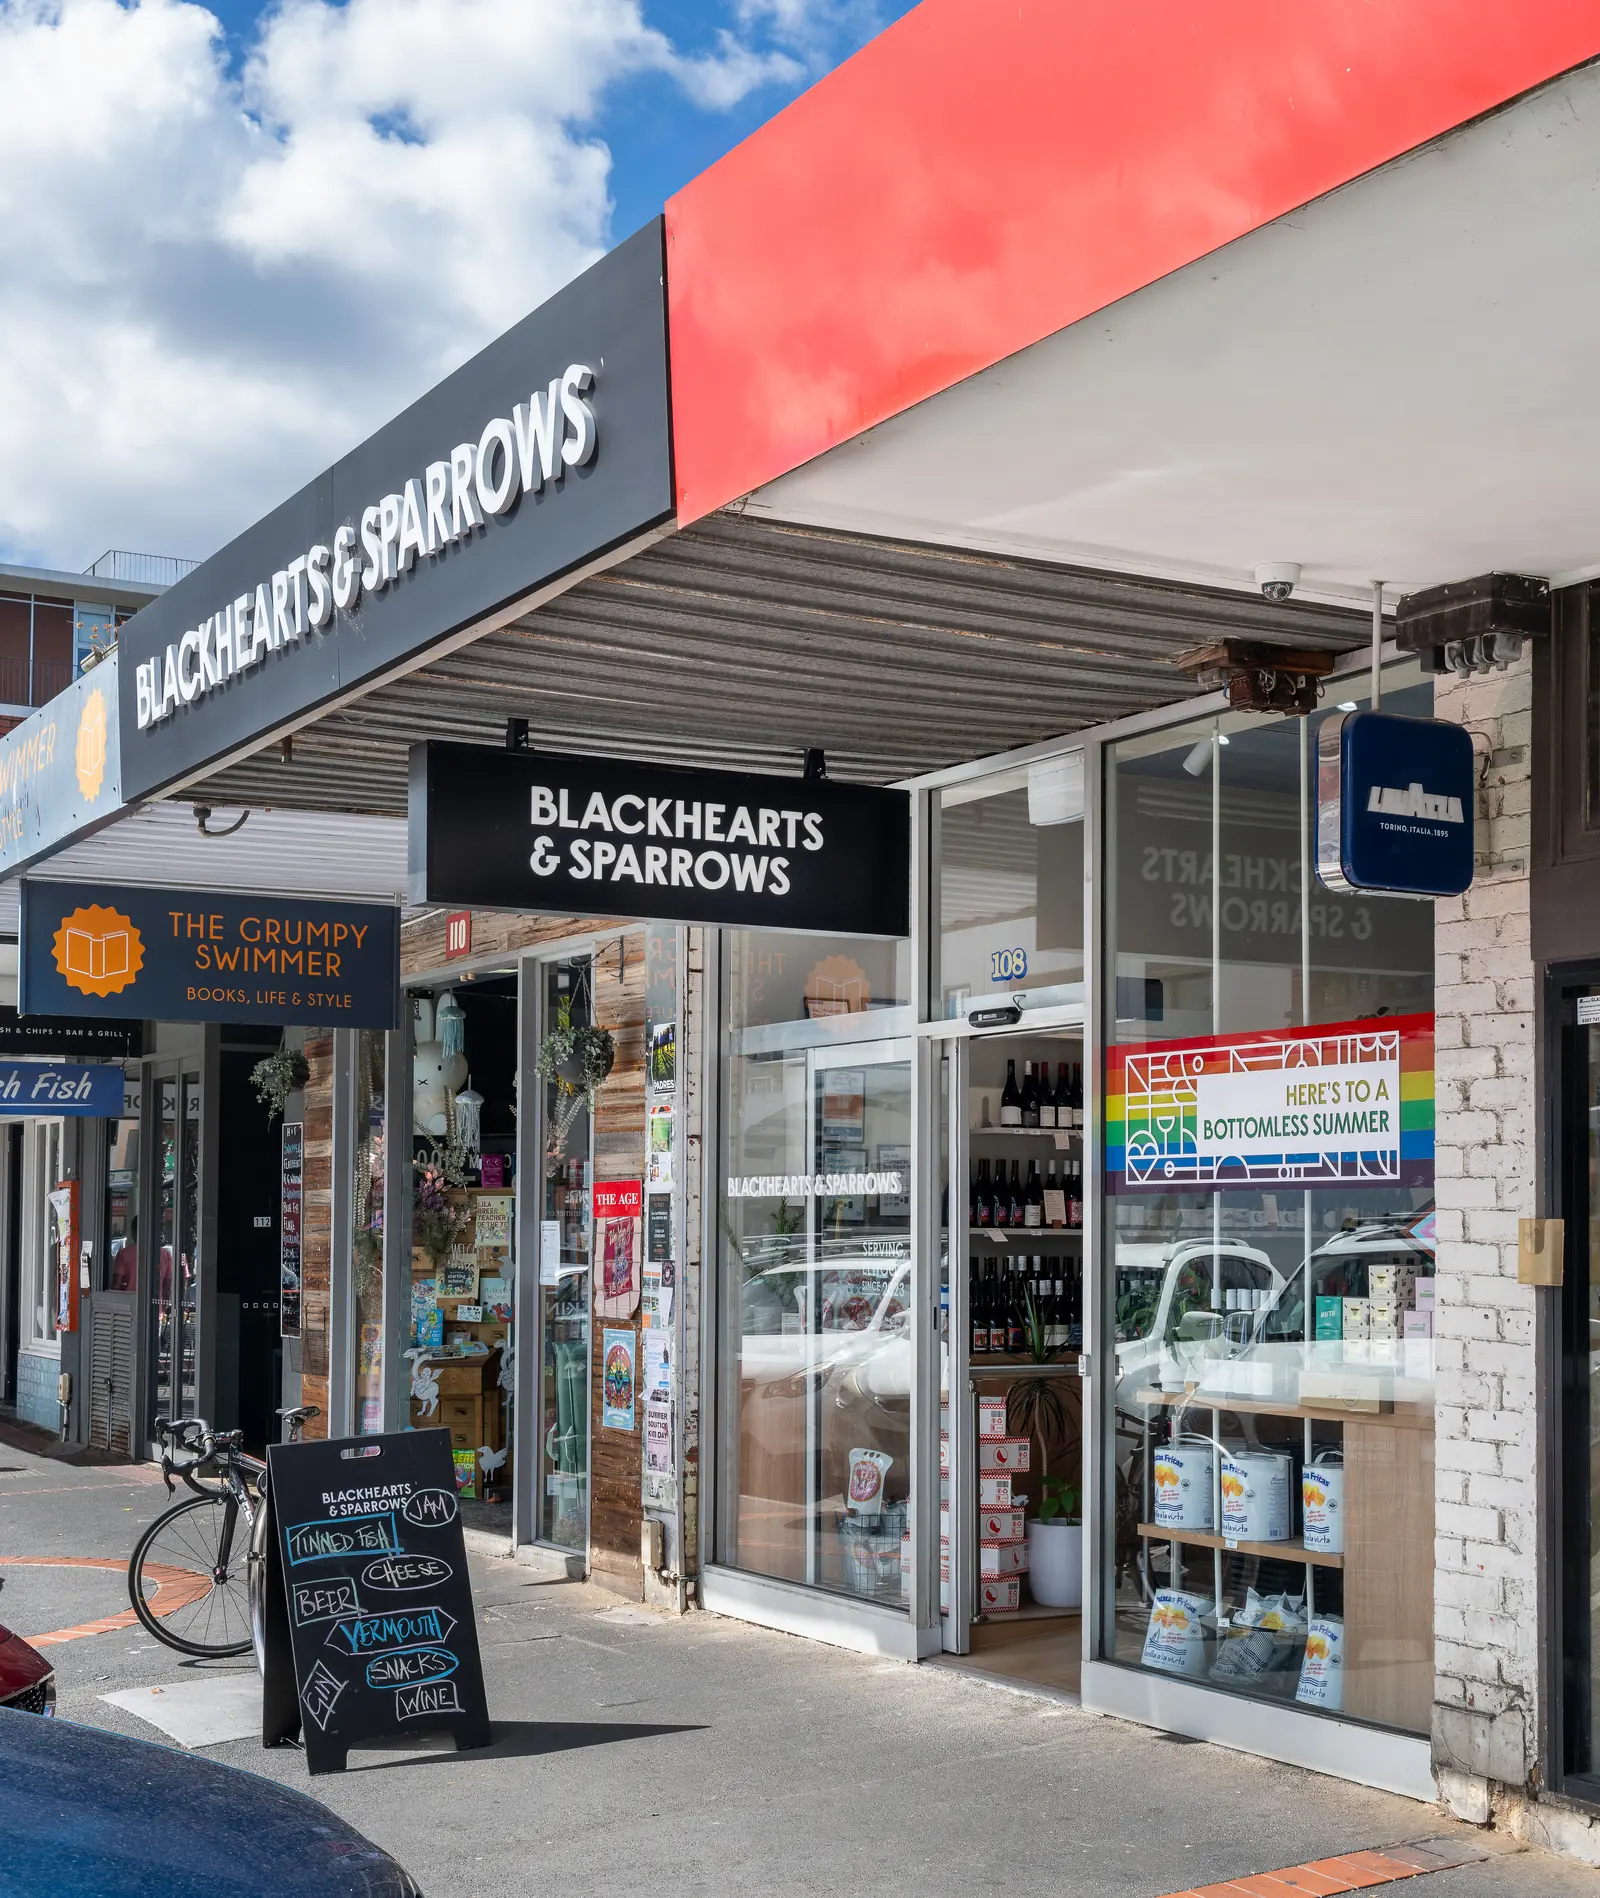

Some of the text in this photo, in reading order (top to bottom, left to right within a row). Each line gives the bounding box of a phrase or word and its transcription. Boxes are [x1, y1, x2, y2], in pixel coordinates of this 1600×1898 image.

[136, 363, 596, 730] BLACKHEARTS & SPARROWS
[530, 785, 825, 851] BLACKHEARTS
[530, 835, 791, 896] & SPARROWS
[168, 911, 369, 949] THE GRUMPY
[450, 919, 467, 951] 110
[195, 944, 342, 977] SWIMMER
[991, 947, 1028, 982] 108
[187, 986, 352, 1008] BOOKS, LIFE & STYLE
[97, 1030, 124, 1038] GRILL
[31, 1071, 92, 1100] Fish
[654, 1079, 675, 1090] PADRES
[1286, 1078, 1389, 1107] HERE'S TO A
[1203, 1110, 1389, 1141] BOTTOMLESS SUMMER
[728, 1172, 903, 1197] BLACKHEARTS & SPARROWS
[596, 1193, 616, 1206] THE
[618, 1192, 639, 1205] AGE
[255, 1217, 270, 1227] 112
[862, 1242, 904, 1257] SERVING
[882, 1281, 905, 1298] 223
[648, 1411, 668, 1420] SUMMER
[657, 1431, 668, 1439] DAY
[321, 1483, 412, 1504] BLACKHEARTS
[329, 1497, 407, 1517] & SPARROWS
[409, 1494, 449, 1520] JAM
[290, 1526, 354, 1556] TINNED
[369, 1560, 444, 1588] CHEESE
[295, 1586, 362, 1617] BEER
[339, 1609, 443, 1653] VERMOUTH
[371, 1654, 447, 1681] SNACKS
[306, 1671, 340, 1715] GIN
[400, 1685, 455, 1715] WINE
